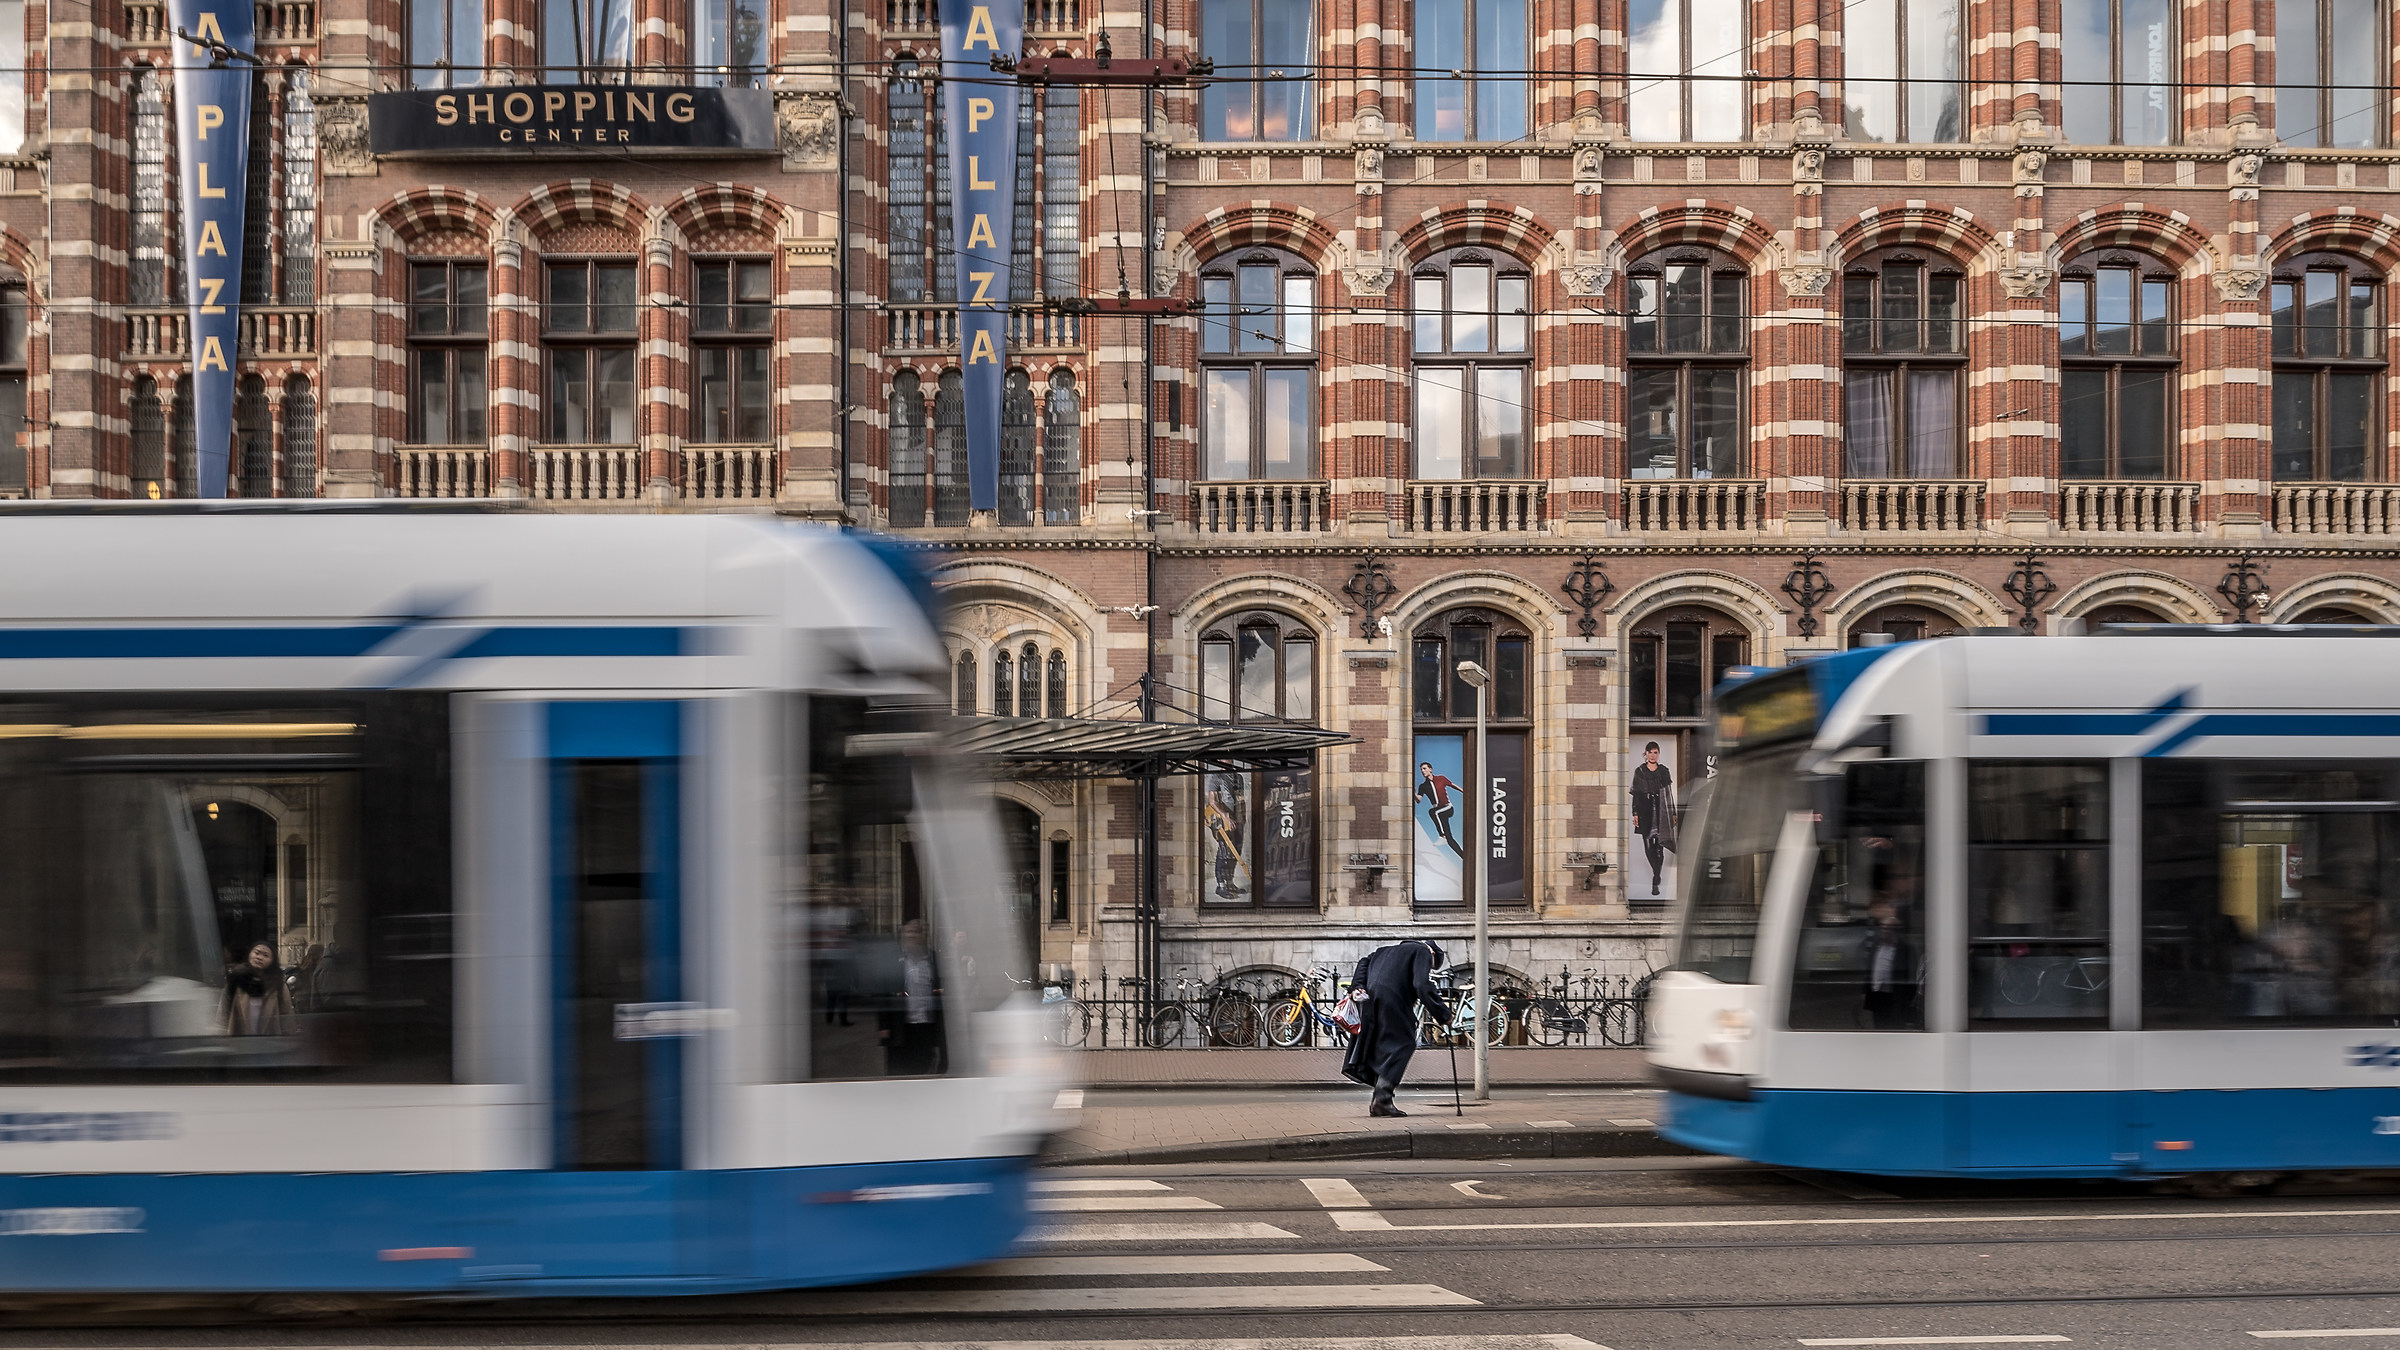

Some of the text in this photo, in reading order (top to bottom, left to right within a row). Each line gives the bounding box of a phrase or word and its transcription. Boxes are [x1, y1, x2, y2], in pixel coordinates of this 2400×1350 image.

[2148, 22, 2163, 111] TONI&GUY
[435, 91, 695, 126] SHOPPING
[500, 129, 630, 143] CENTER
[197, 104, 228, 372] PLAZA
[967, 97, 998, 365] PLAZA
[1281, 801, 1294, 838] MCS
[1493, 777, 1507, 859] LACOSTE
